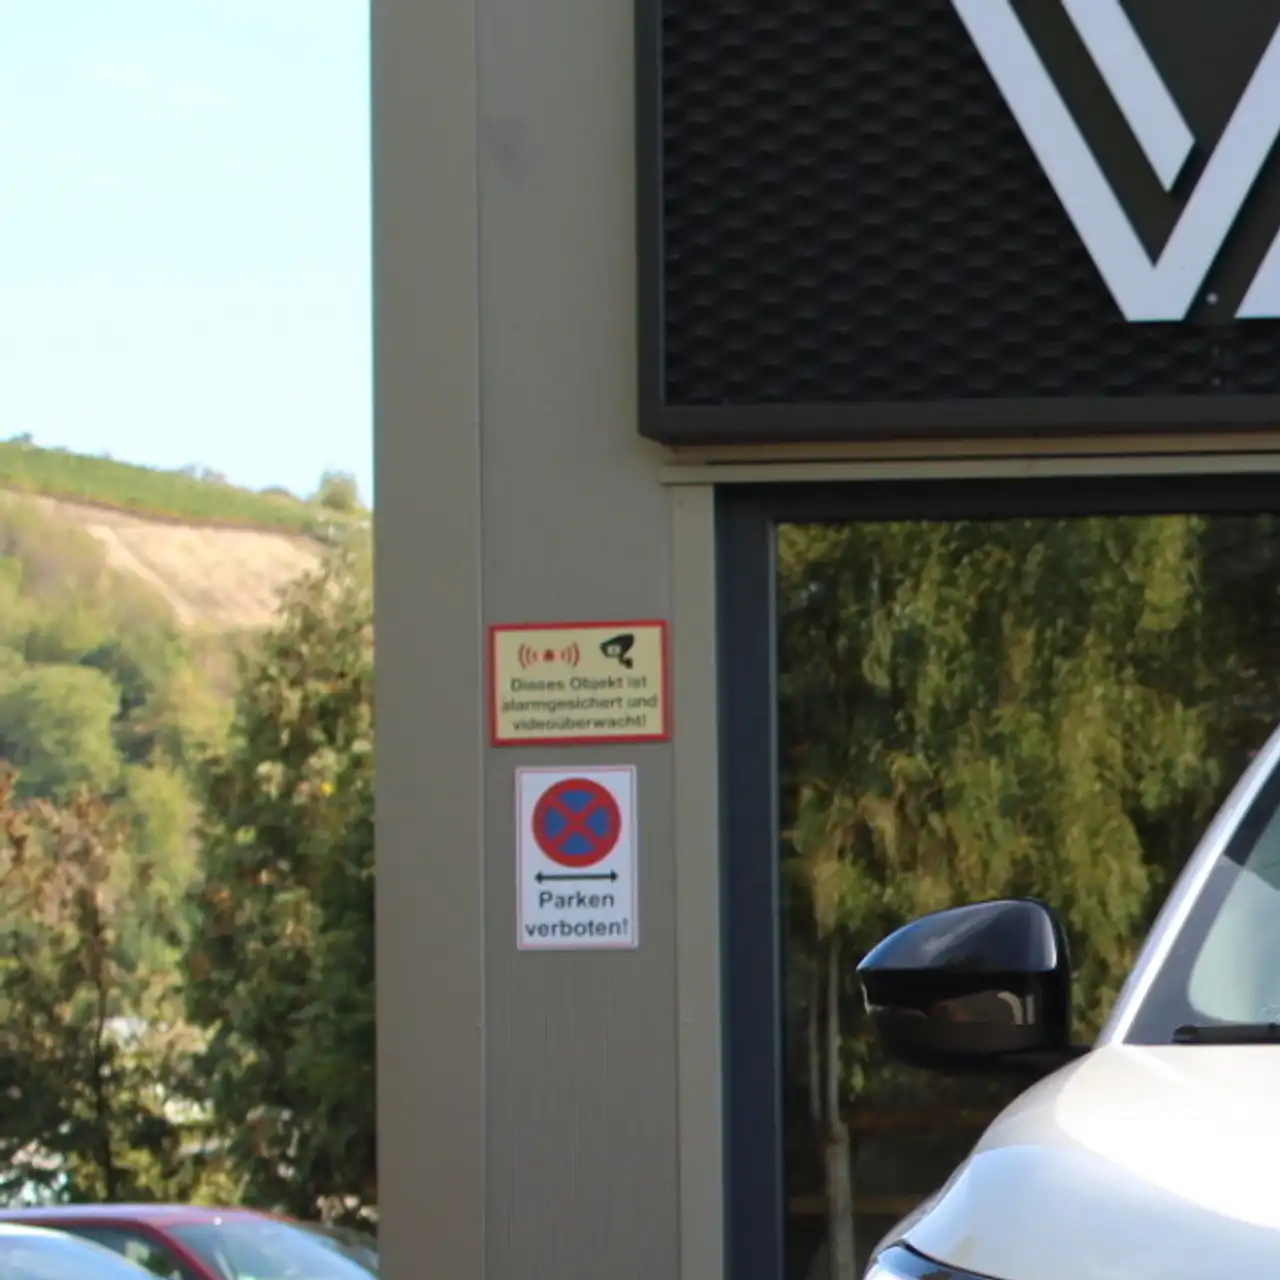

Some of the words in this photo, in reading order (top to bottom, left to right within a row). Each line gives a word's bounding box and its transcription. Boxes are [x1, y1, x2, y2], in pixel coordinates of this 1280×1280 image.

[510, 677, 565, 692] Dieses
[569, 676, 624, 692] Objekt
[627, 675, 647, 690] ist
[501, 695, 624, 713] alarmgesichert
[627, 693, 658, 709] und
[512, 714, 647, 732] videoüberwacht!
[538, 890, 615, 909] Parken
[524, 917, 629, 938] verboten!
